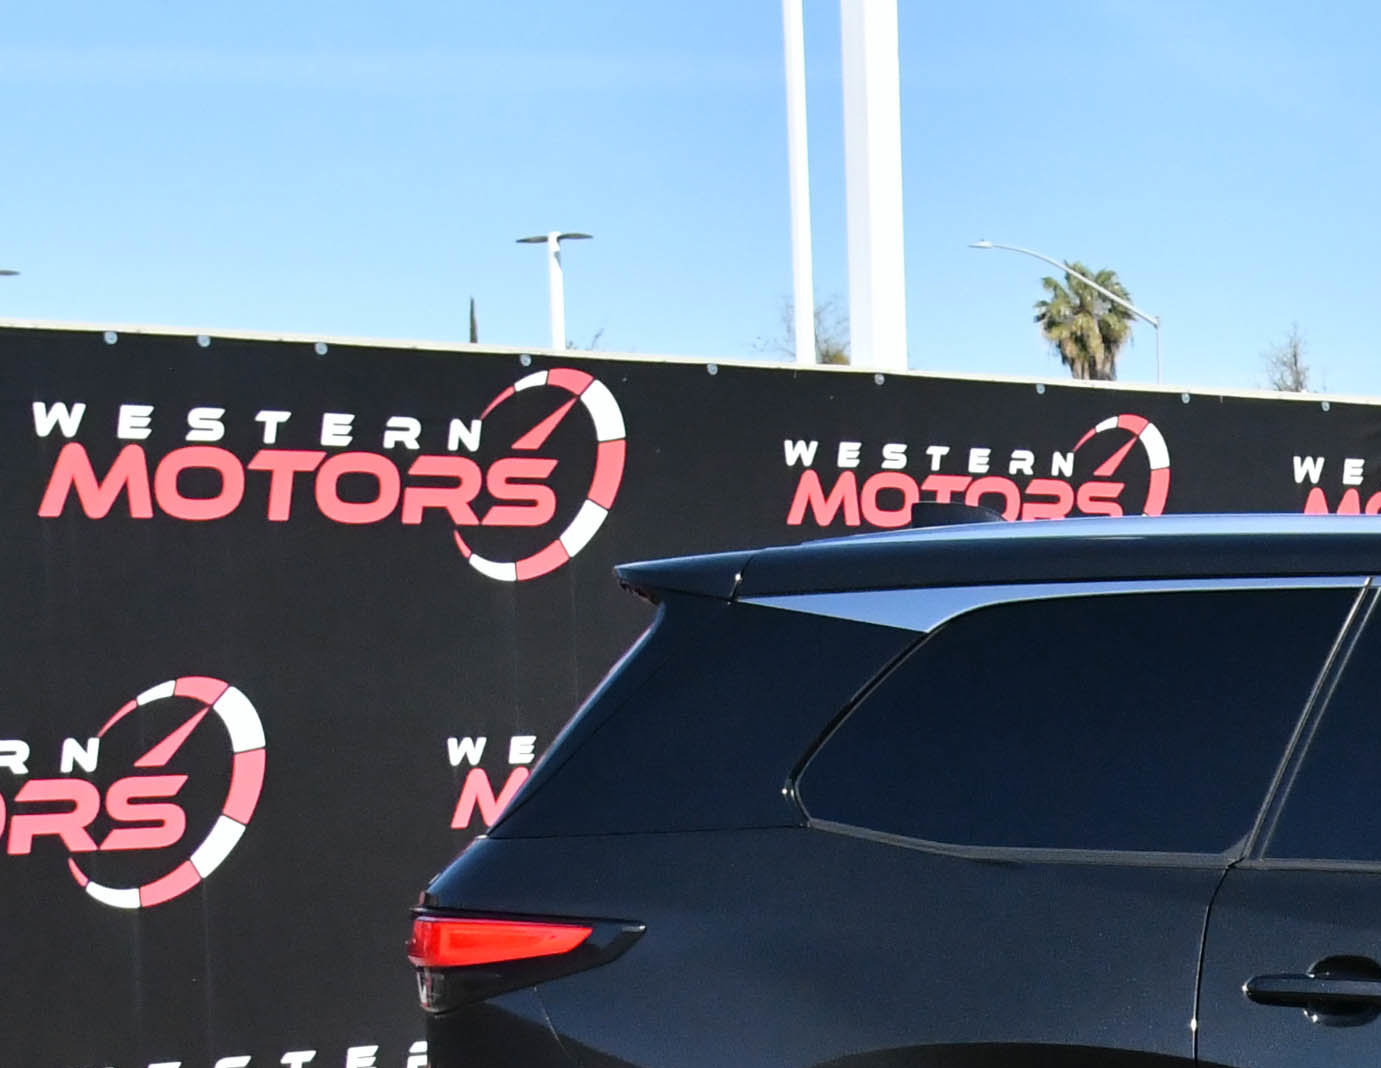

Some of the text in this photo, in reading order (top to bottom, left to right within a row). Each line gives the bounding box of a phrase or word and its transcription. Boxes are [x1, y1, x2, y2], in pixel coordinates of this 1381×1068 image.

[33, 402, 482, 453] WESTERN
[38, 442, 558, 526] MOTORS
[784, 439, 1075, 478] WESTERN
[786, 469, 1126, 528] MOTORS
